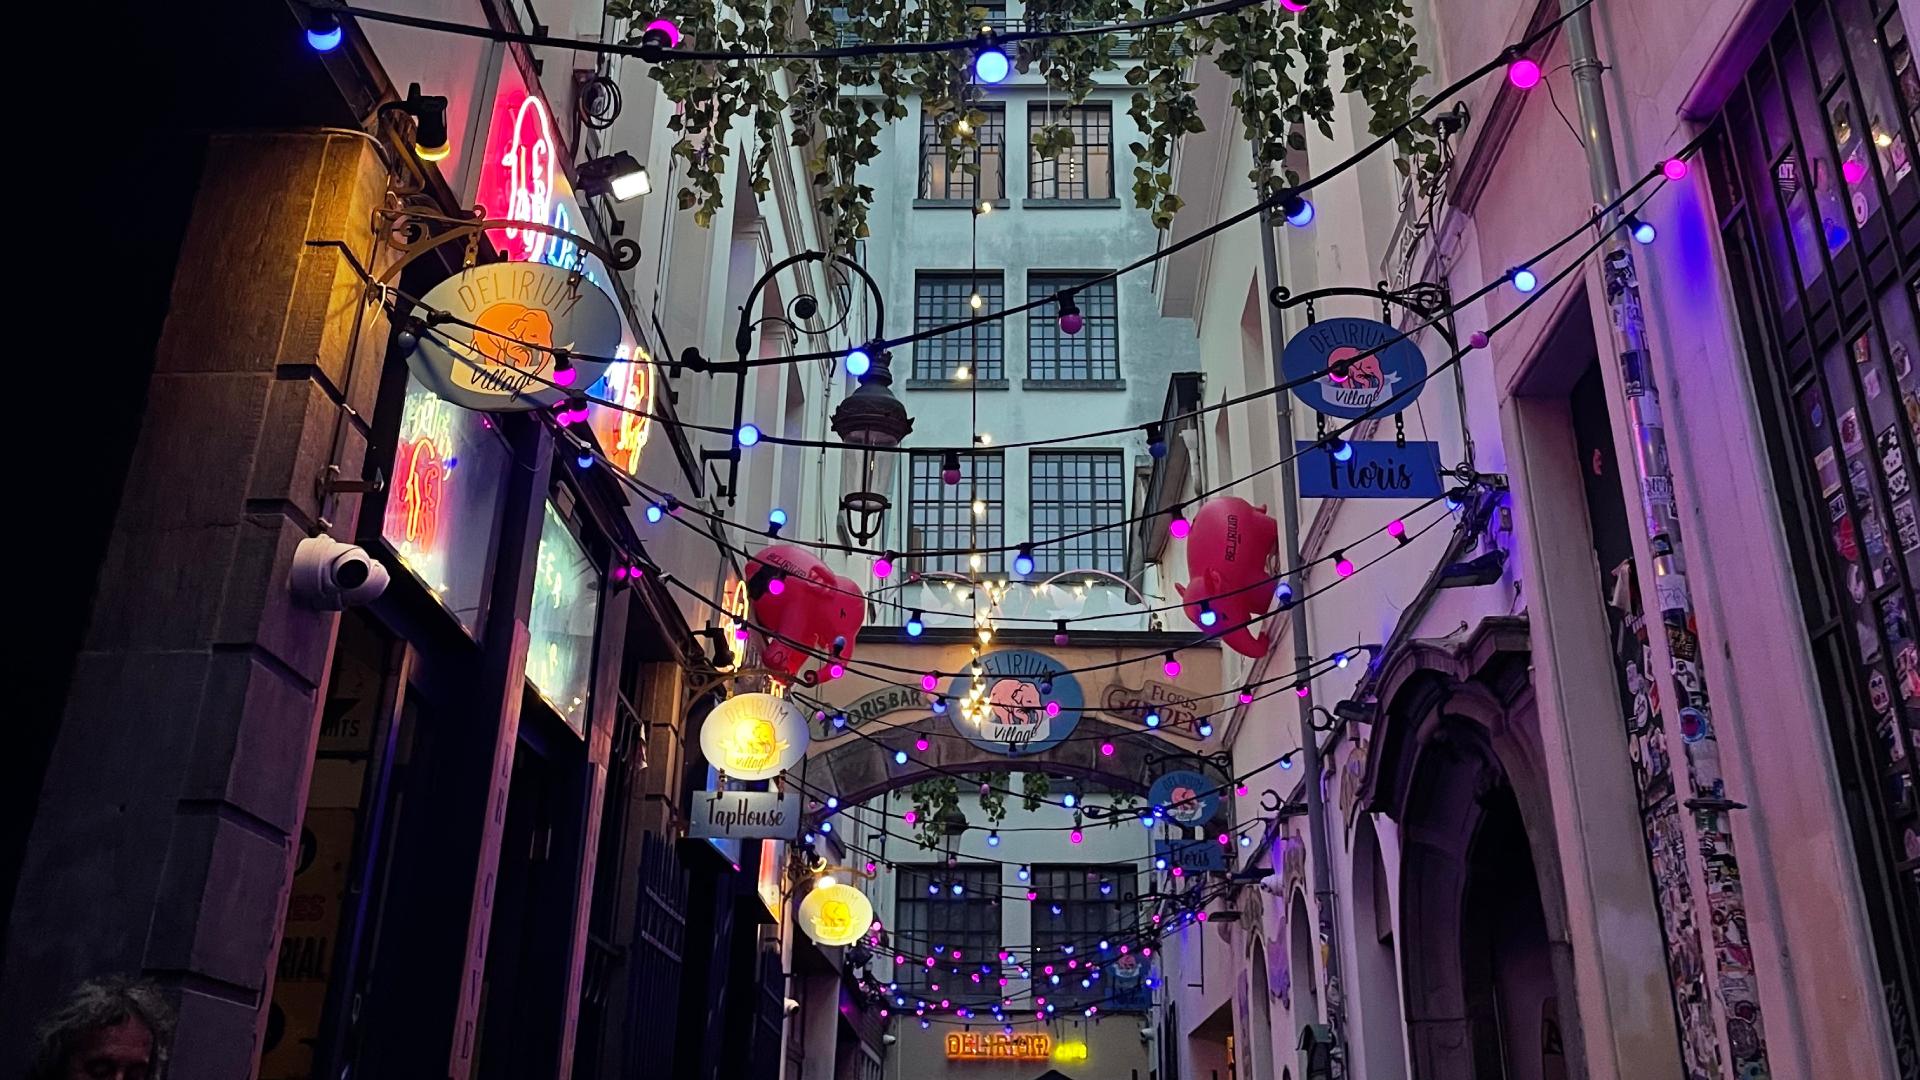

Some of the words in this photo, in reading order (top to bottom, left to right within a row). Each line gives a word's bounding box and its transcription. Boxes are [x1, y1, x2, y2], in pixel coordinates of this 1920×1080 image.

[457, 269, 583, 318] DELIRIUM
[471, 367, 539, 402] Village
[1336, 389, 1378, 411] Village
[1327, 448, 1413, 491] Floris
[977, 653, 1056, 684] ELIRIU
[724, 696, 789, 726] DELIRIUM
[1107, 688, 1202, 733] GADEN
[994, 726, 1037, 750] Village
[706, 797, 785, 834] TapHouse
